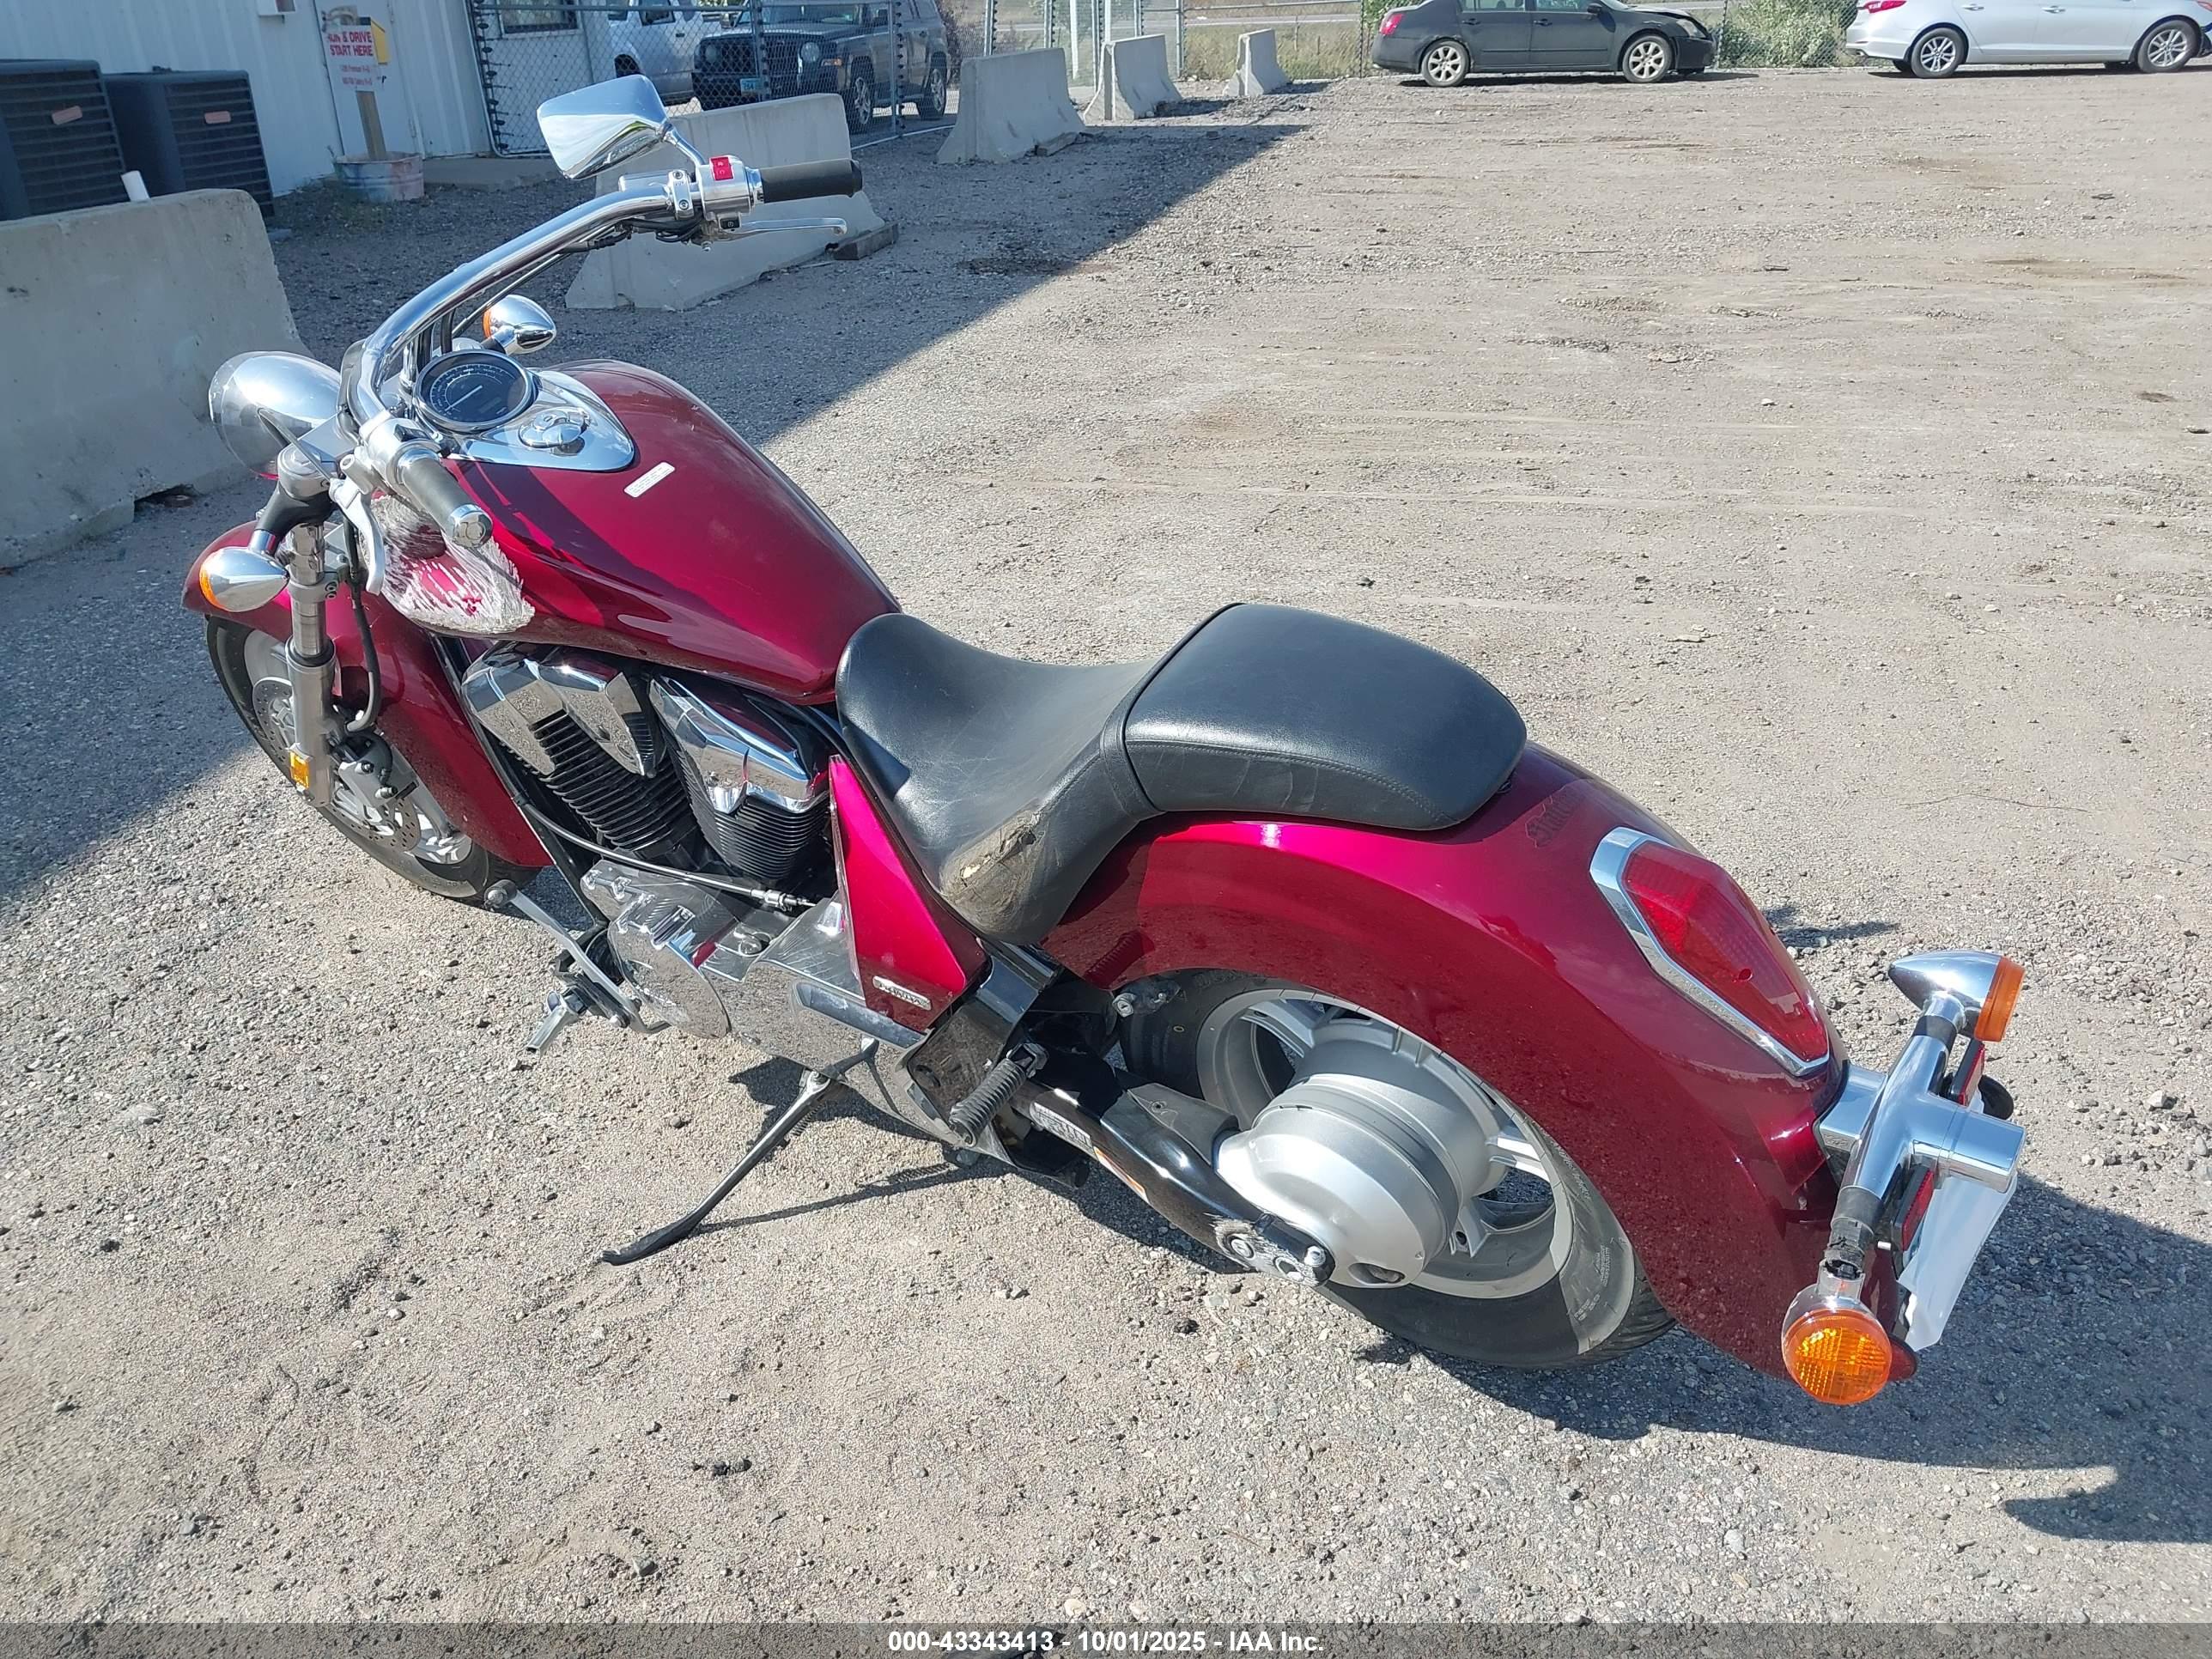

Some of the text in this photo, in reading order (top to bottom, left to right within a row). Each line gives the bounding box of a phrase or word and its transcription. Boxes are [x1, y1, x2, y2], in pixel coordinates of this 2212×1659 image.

[349, 32, 372, 42] DRIVE
[330, 46, 374, 56] START HERE
